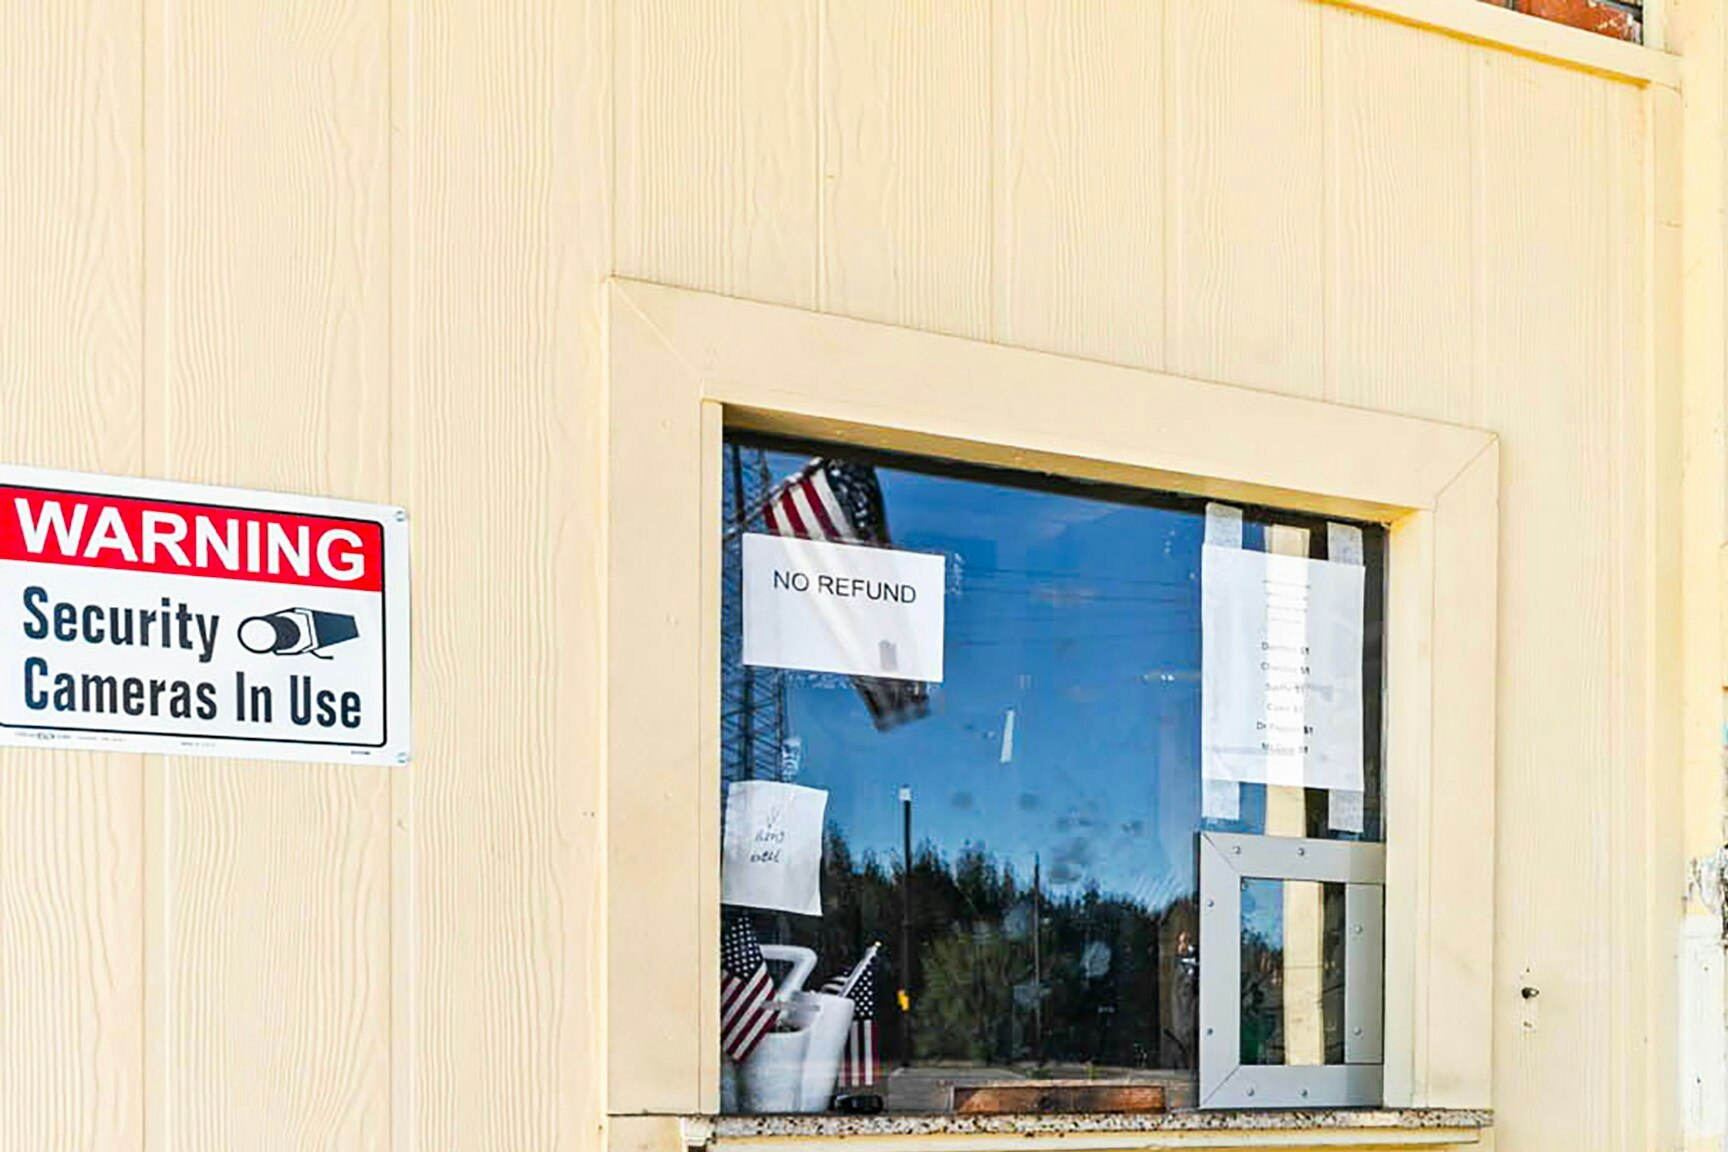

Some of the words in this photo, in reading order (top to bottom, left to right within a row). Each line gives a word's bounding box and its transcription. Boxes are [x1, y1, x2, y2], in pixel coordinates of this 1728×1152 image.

[14, 497, 365, 581] WARNING
[23, 586, 220, 663] Security
[773, 570, 810, 592] NO
[817, 575, 917, 604] REFUND
[24, 656, 217, 720] Cameras
[236, 671, 273, 722] In
[289, 675, 362, 729] Use
